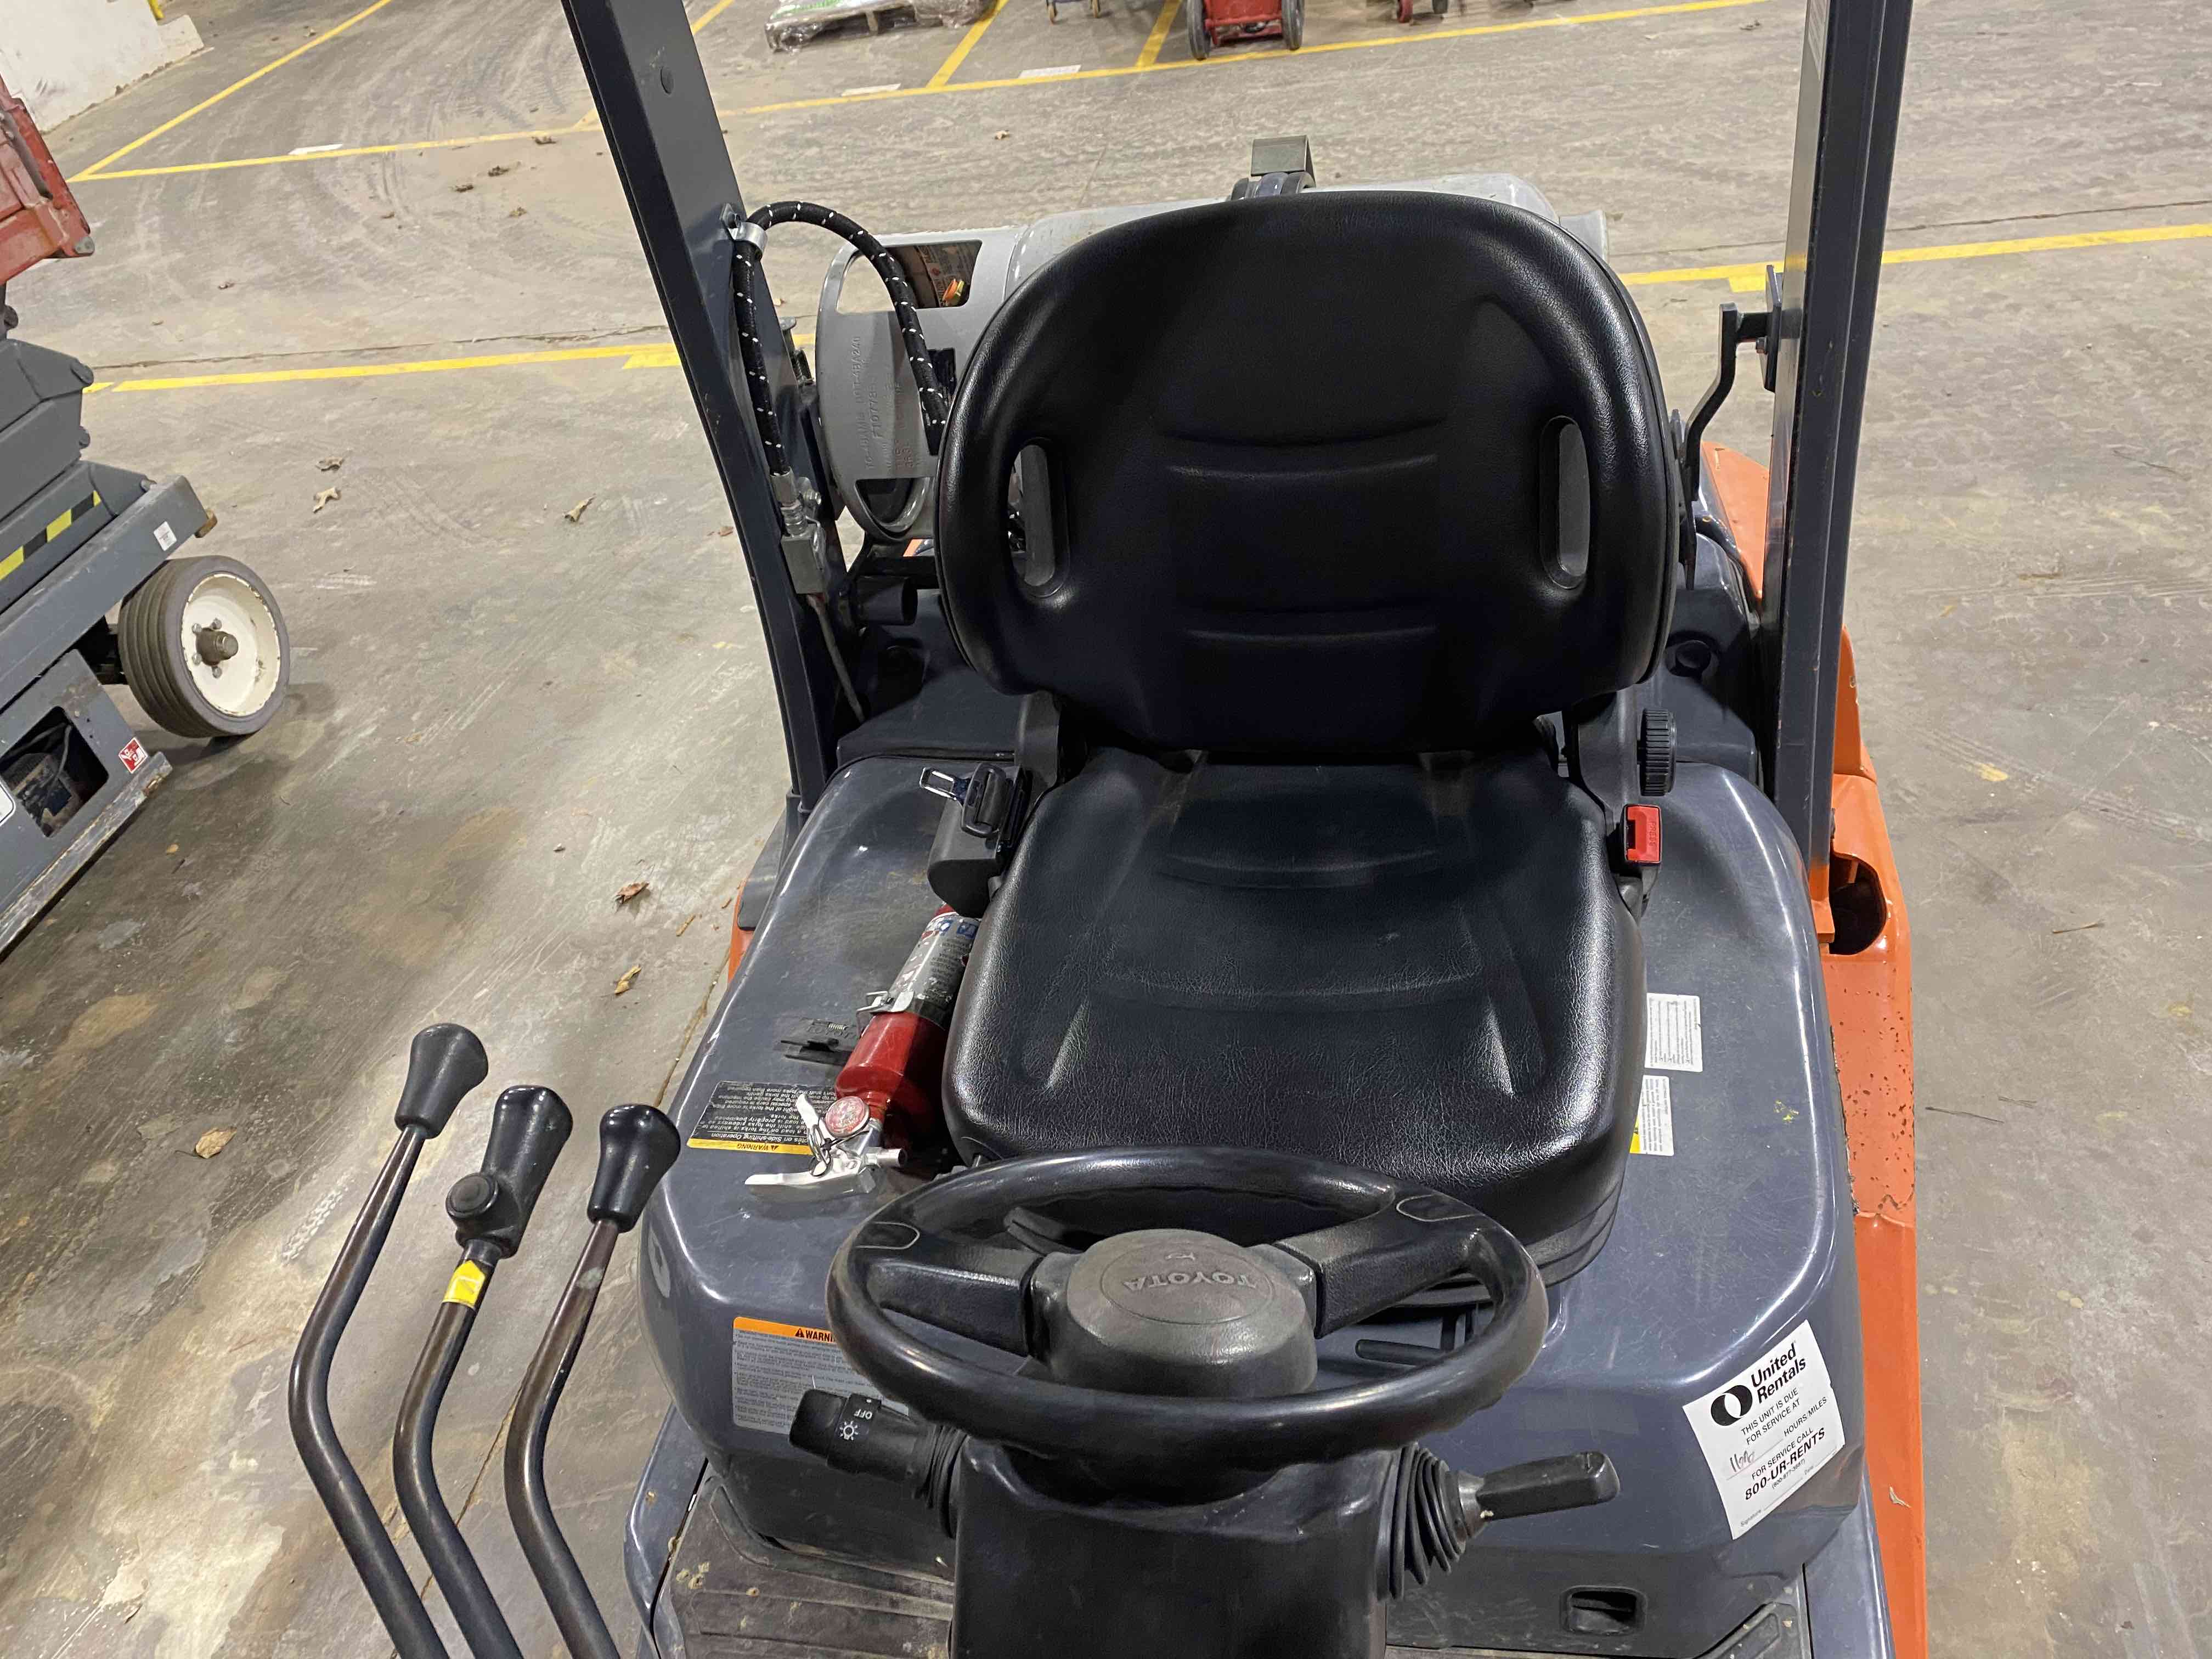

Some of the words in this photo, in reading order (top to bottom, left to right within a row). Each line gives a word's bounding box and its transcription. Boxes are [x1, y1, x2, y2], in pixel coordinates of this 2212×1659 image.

[1122, 1271, 1257, 1291] TOYOTA
[805, 1330, 834, 1342] WARNI
[1751, 1342, 1797, 1387] United
[1757, 1358, 1806, 1404] Rentals
[854, 1409, 872, 1420] OFF
[1741, 1420, 1758, 1435] THIS
[1759, 1406, 1775, 1423] UNIT
[1776, 1400, 1783, 1409] IS
[1784, 1387, 1798, 1403] DUE
[1746, 1430, 1762, 1445] FOR
[1762, 1406, 1791, 1433] SERVICE
[1792, 1399, 1800, 1409] AT
[1745, 1427, 1825, 1500] 800-UR-RENTS
[1752, 1465, 1767, 1480] FOR
[1768, 1441, 1796, 1468] SERVICE
[1797, 1427, 1813, 1443] CALL
